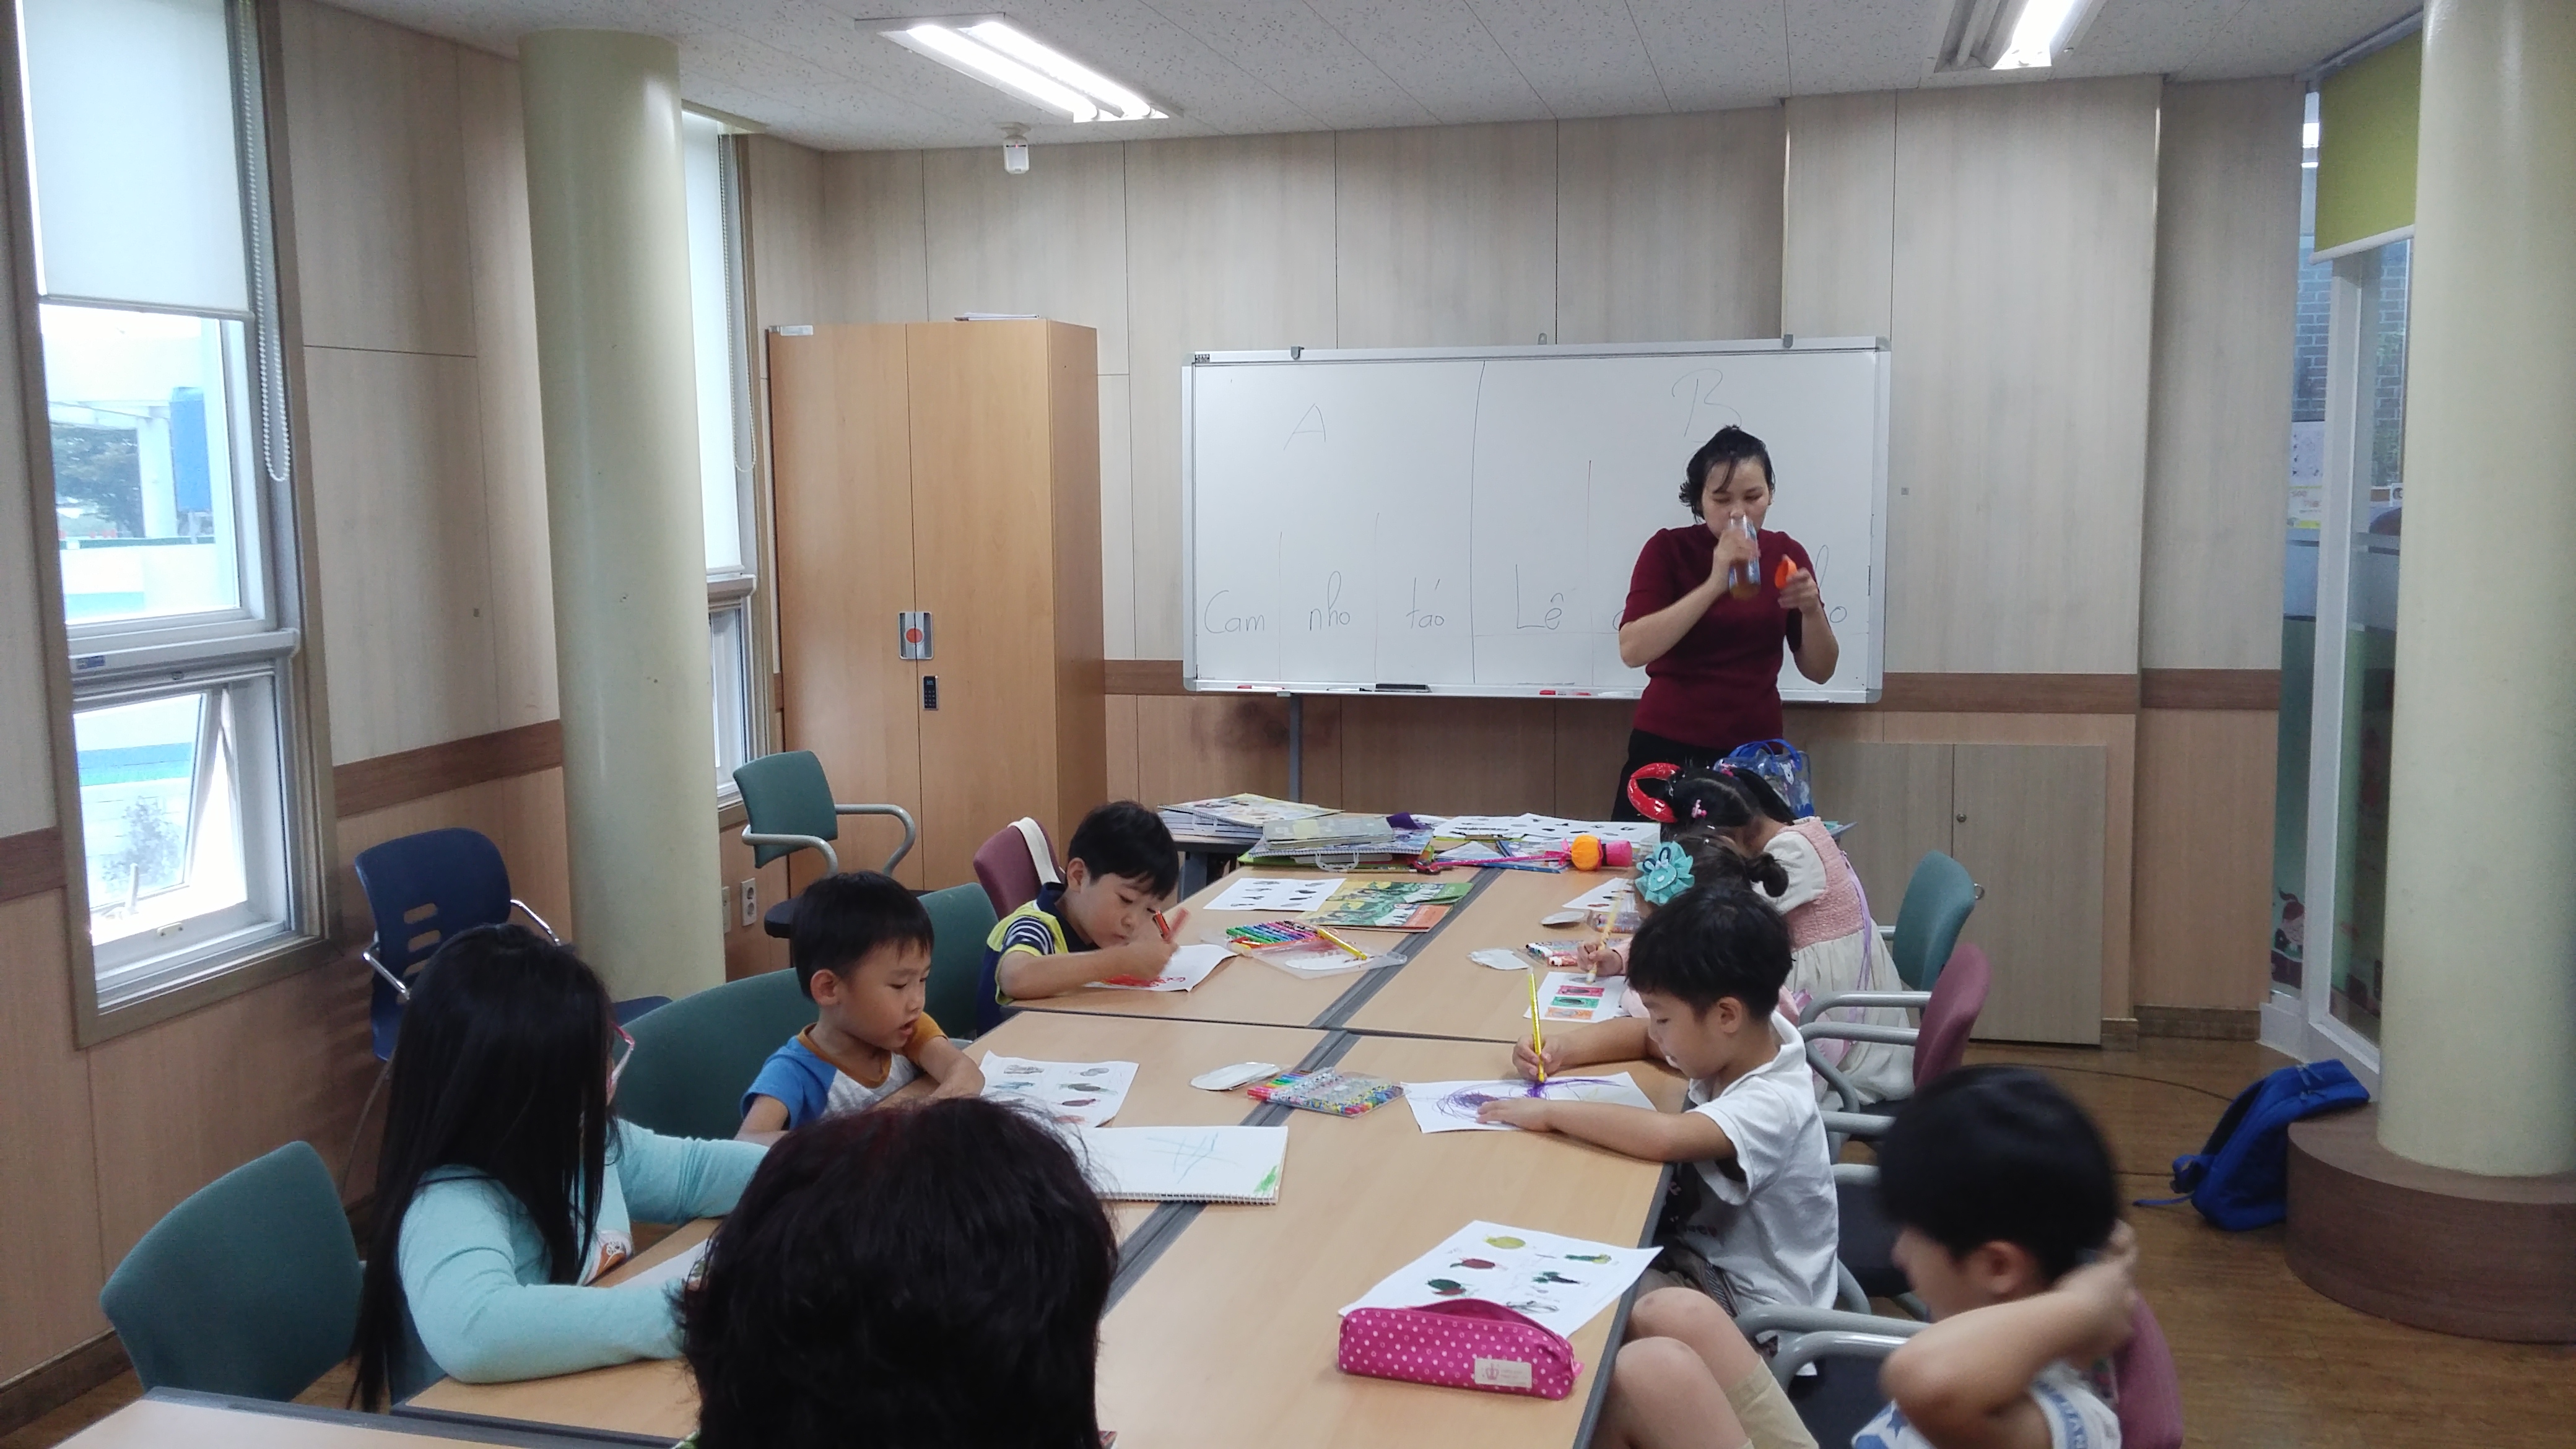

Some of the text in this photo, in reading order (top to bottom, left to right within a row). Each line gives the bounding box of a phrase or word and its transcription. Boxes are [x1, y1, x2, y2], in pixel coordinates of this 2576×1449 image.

[1283, 402, 1326, 451] A
[1204, 590, 1265, 634] Cam
[1308, 570, 1351, 632] nho
